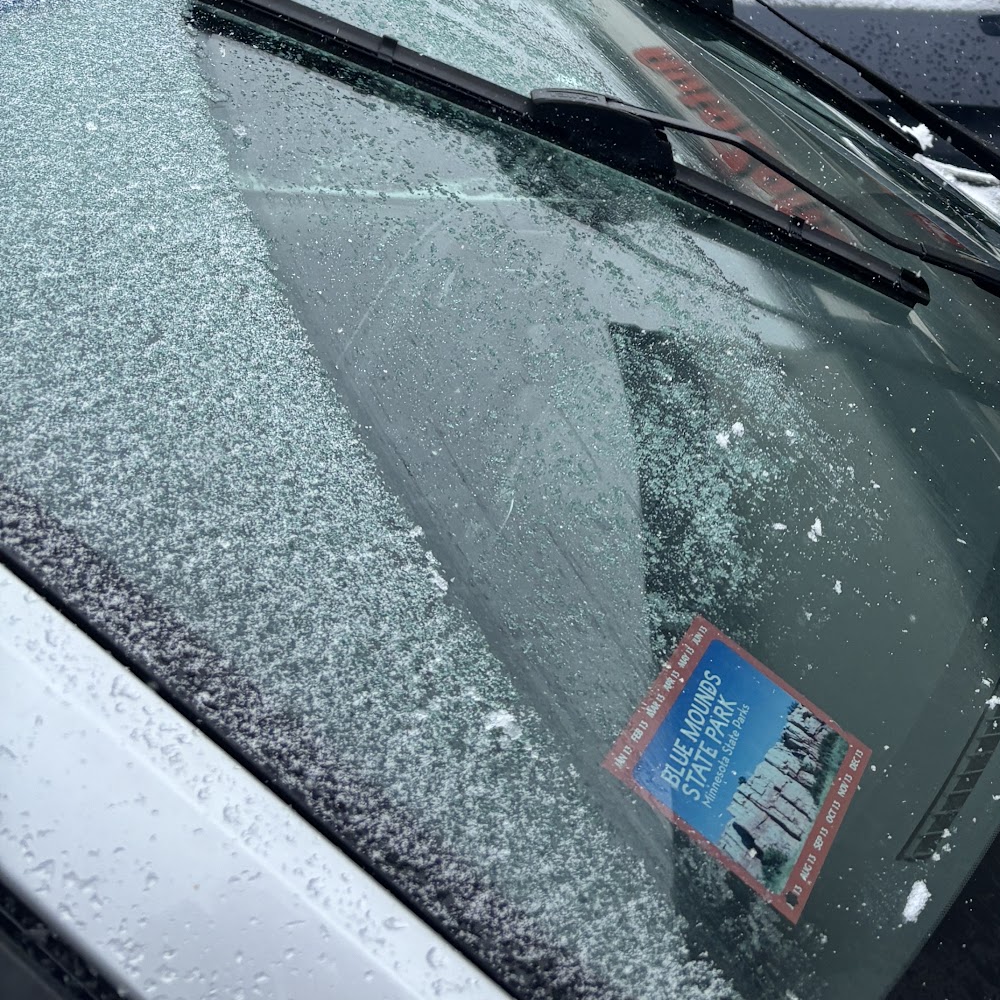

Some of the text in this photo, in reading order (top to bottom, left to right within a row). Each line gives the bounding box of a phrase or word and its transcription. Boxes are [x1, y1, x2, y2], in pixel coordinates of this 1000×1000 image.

[631, 728, 643, 743] FEB
[661, 670, 722, 790] BLUE MOUNDS
[682, 693, 737, 801] STATE PARK
[702, 703, 750, 809] Minnesota State Parks
[800, 863, 812, 881] AUG
[814, 835, 824, 850] SEP
[826, 808, 837, 824] OCT
[838, 781, 850, 797] NOV
[849, 756, 860, 771] DEC
